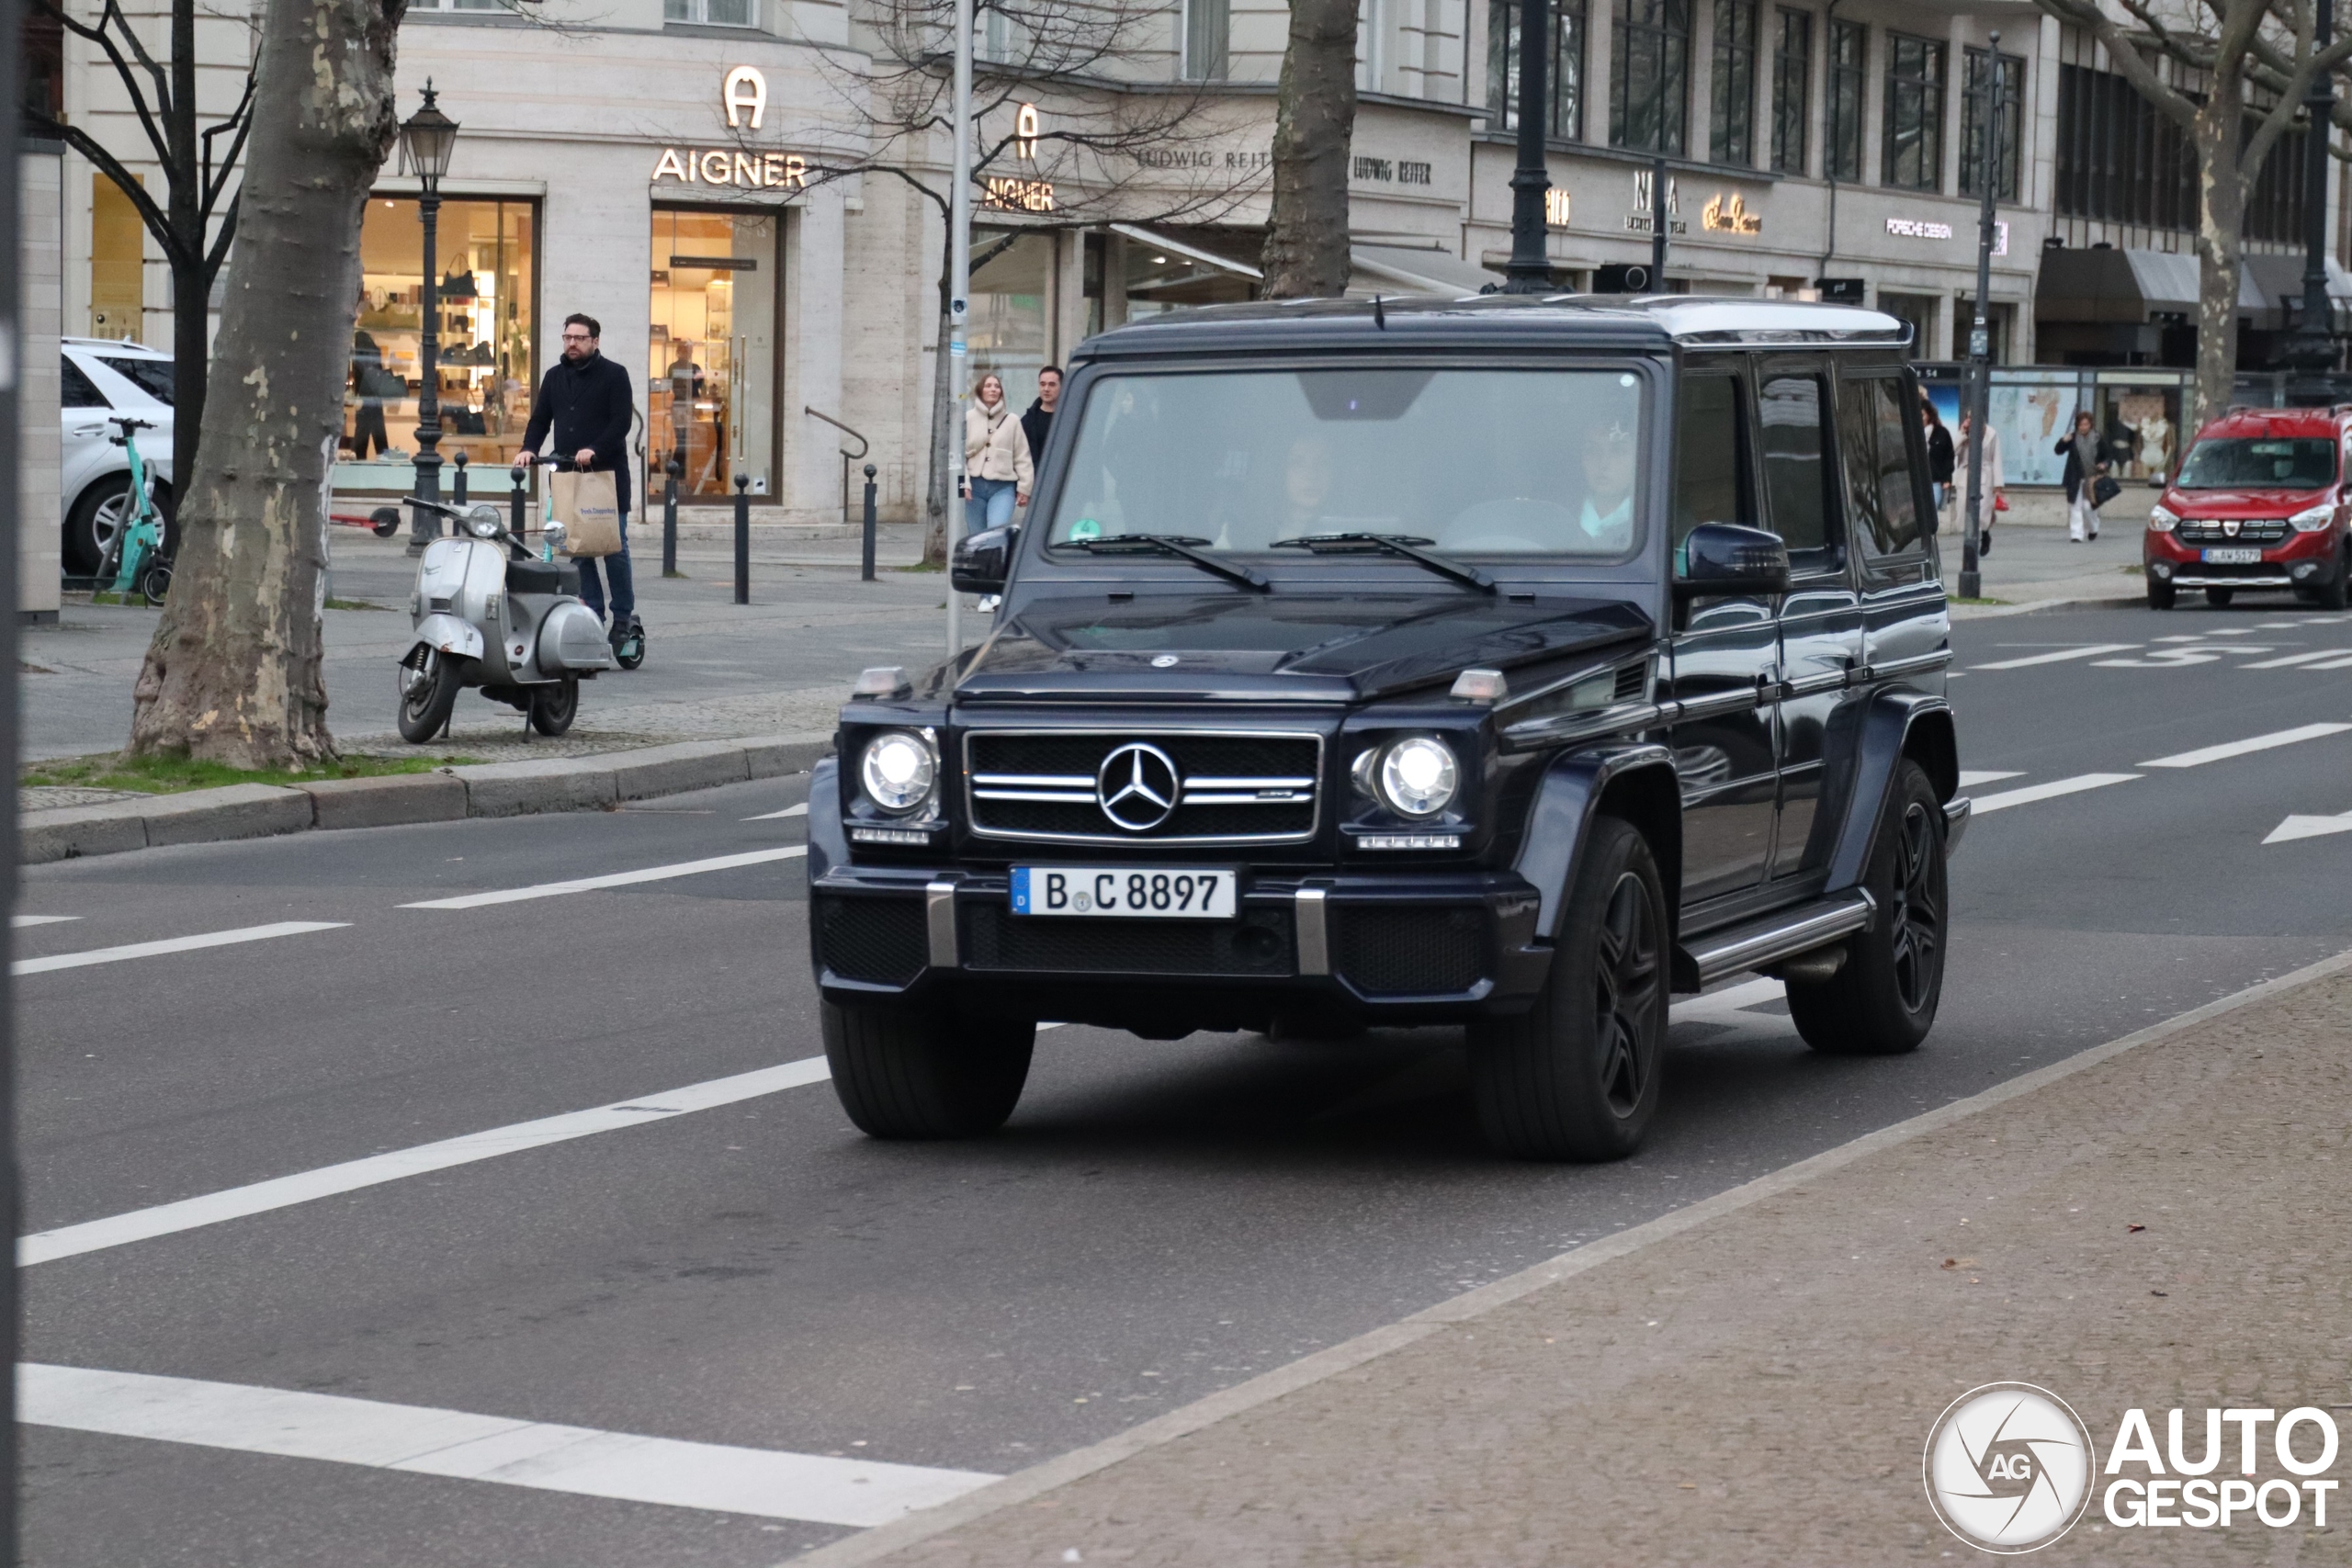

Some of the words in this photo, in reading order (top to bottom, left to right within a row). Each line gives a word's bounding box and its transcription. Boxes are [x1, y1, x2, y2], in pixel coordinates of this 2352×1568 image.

[652, 148, 806, 187] AIGNER
[1137, 149, 1212, 168] LUDWIG
[1226, 152, 1270, 168] REIT
[1354, 156, 1392, 182] LUDWIG
[1398, 161, 1431, 185] REITER
[985, 177, 1054, 211] AIGNER
[1885, 219, 1924, 237] PORSCHE
[1924, 221, 1952, 239] DESIGN
[1017, 896, 1025, 906] D
[1046, 874, 1069, 909] B
[1095, 874, 1116, 910] C
[1126, 874, 1218, 911] 8897
